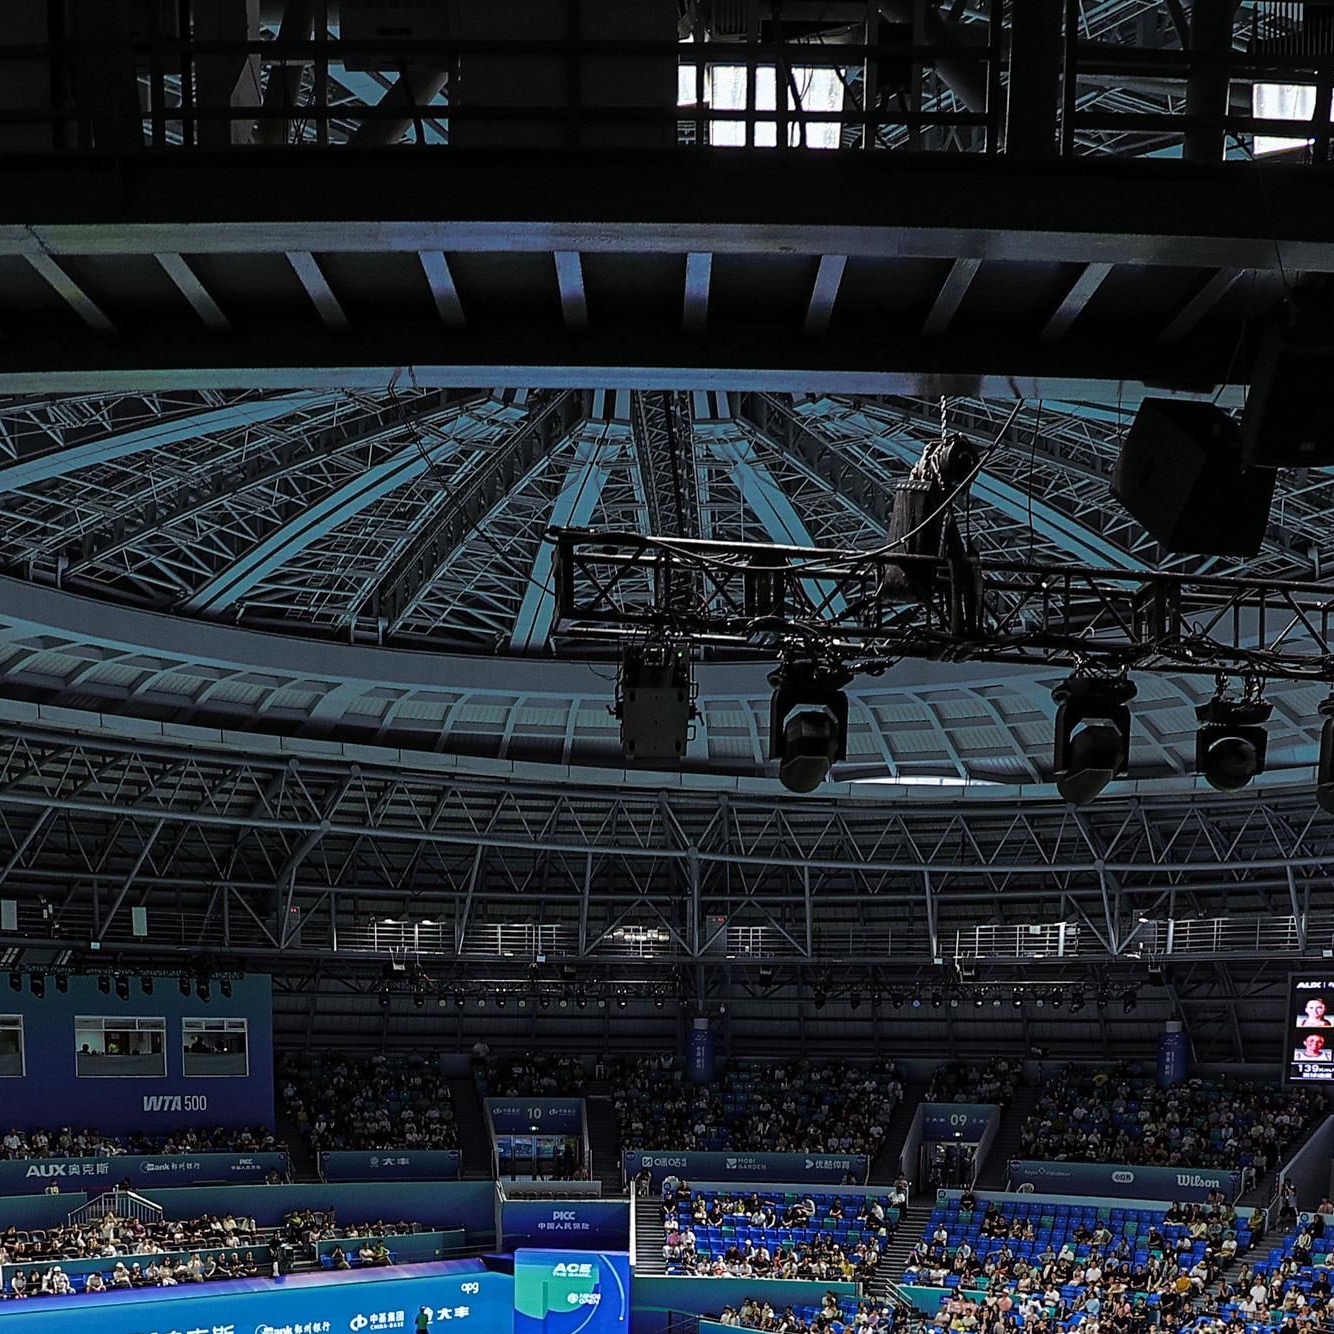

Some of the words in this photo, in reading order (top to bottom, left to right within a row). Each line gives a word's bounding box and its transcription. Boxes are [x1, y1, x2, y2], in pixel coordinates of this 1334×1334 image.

[142, 1095, 183, 1113] WTA
[183, 1095, 207, 1112] 500
[526, 1107, 542, 1120] 10
[950, 1113, 967, 1126] 09
[26, 1163, 67, 1178] AUX
[68, 1162, 110, 1176] 奥克斯
[1176, 1174, 1221, 1189] Wilson
[553, 1211, 576, 1221] PICC
[537, 1222, 590, 1230] 中国人民保险
[553, 1262, 593, 1273] ACE
[369, 1310, 405, 1324] 中基集团
[437, 1306, 470, 1321] 大丰
